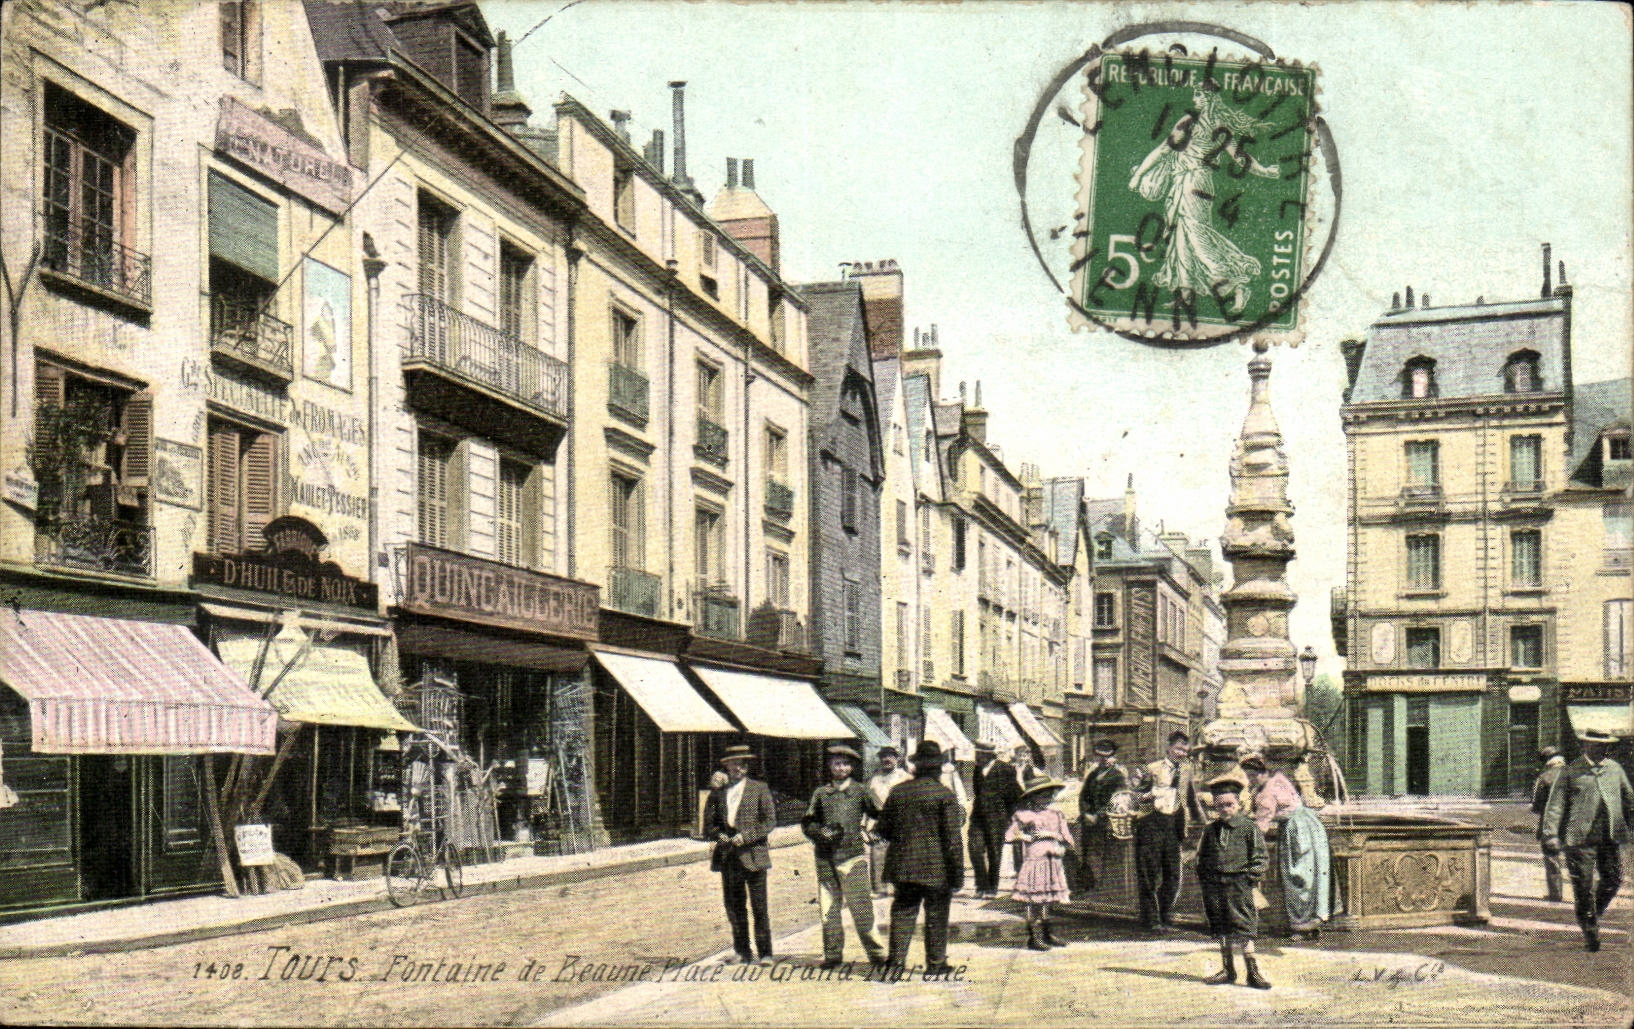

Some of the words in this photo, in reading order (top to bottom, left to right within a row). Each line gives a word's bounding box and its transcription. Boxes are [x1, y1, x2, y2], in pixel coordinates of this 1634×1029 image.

[1223, 72, 1306, 97] FRANÇAISE
[1202, 126, 1257, 180] 25
[1268, 229, 1295, 313] POSTES
[297, 576, 317, 597] DE
[320, 577, 357, 605] NOIX
[413, 556, 596, 629] QUINCAILLERIE
